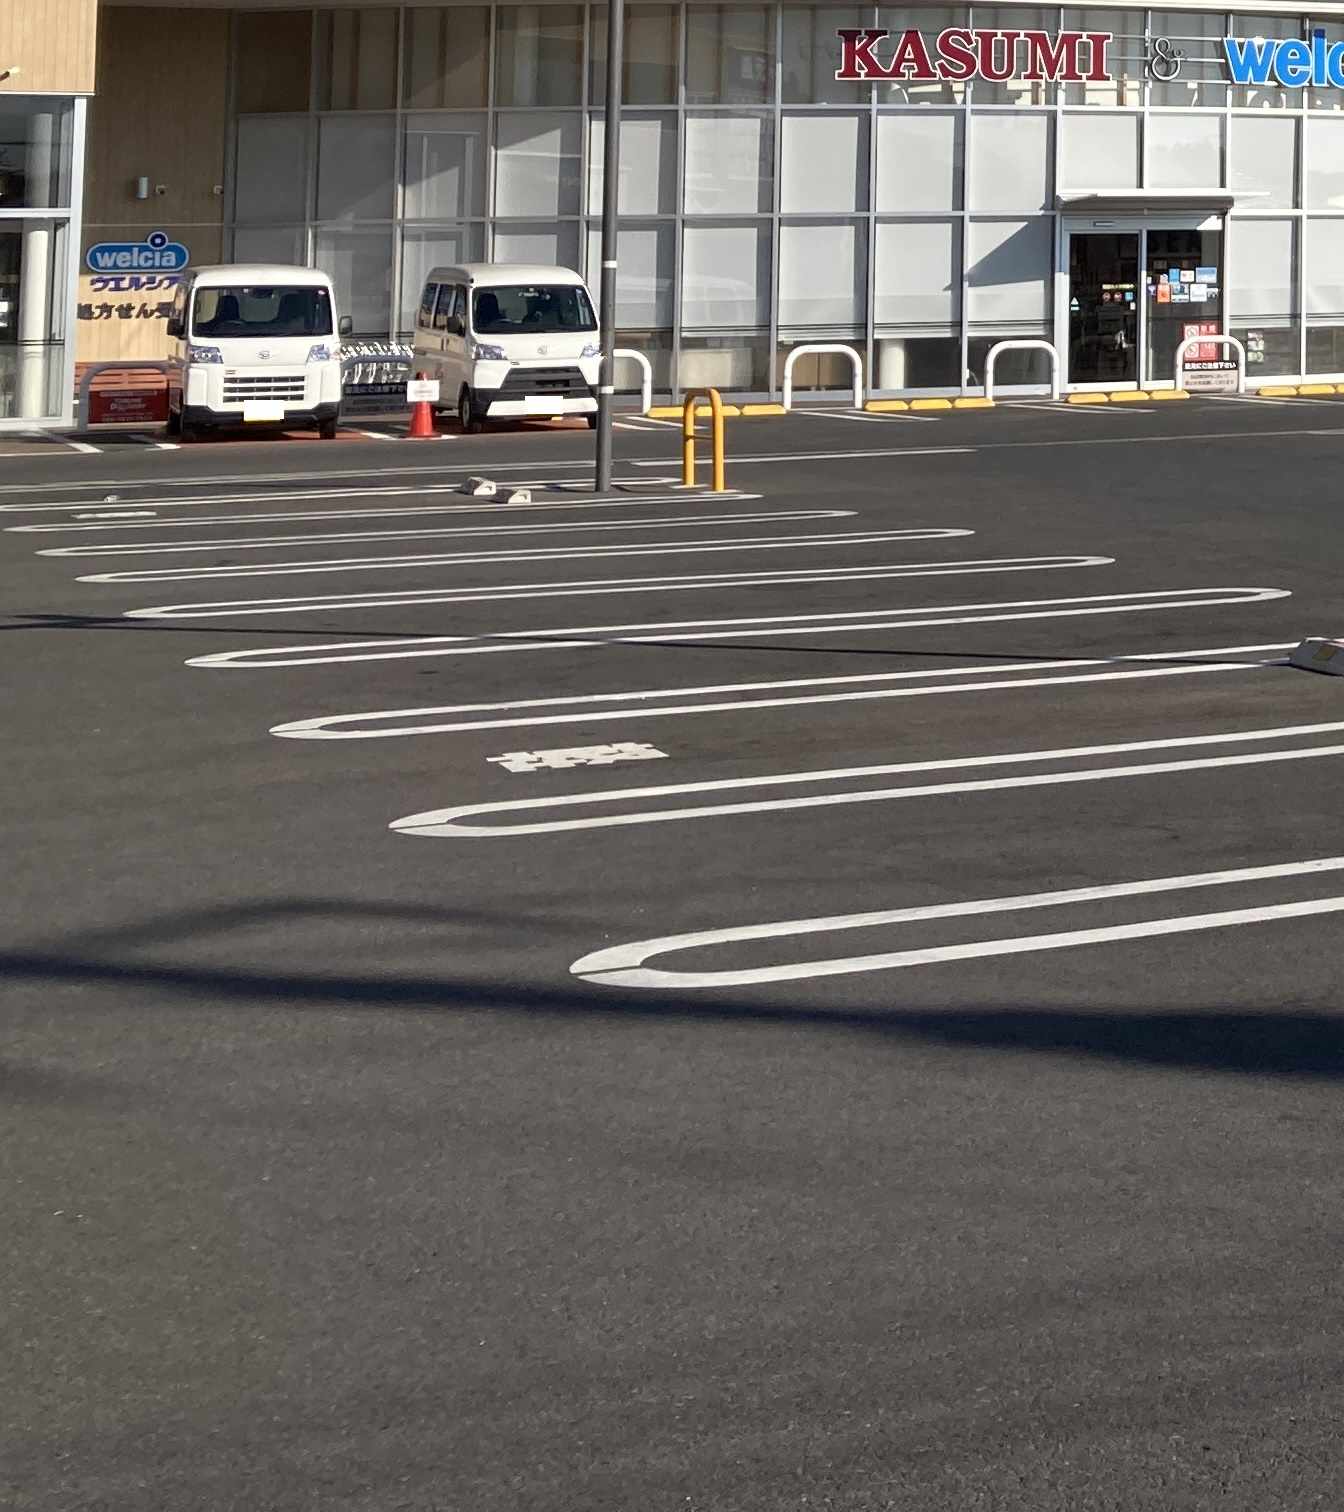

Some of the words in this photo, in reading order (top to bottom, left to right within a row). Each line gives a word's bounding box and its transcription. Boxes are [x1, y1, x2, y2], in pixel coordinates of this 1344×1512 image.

[835, 27, 1113, 82] KASUMI
[94, 241, 177, 268] welcia
[77, 302, 173, 320] 処方せん受
